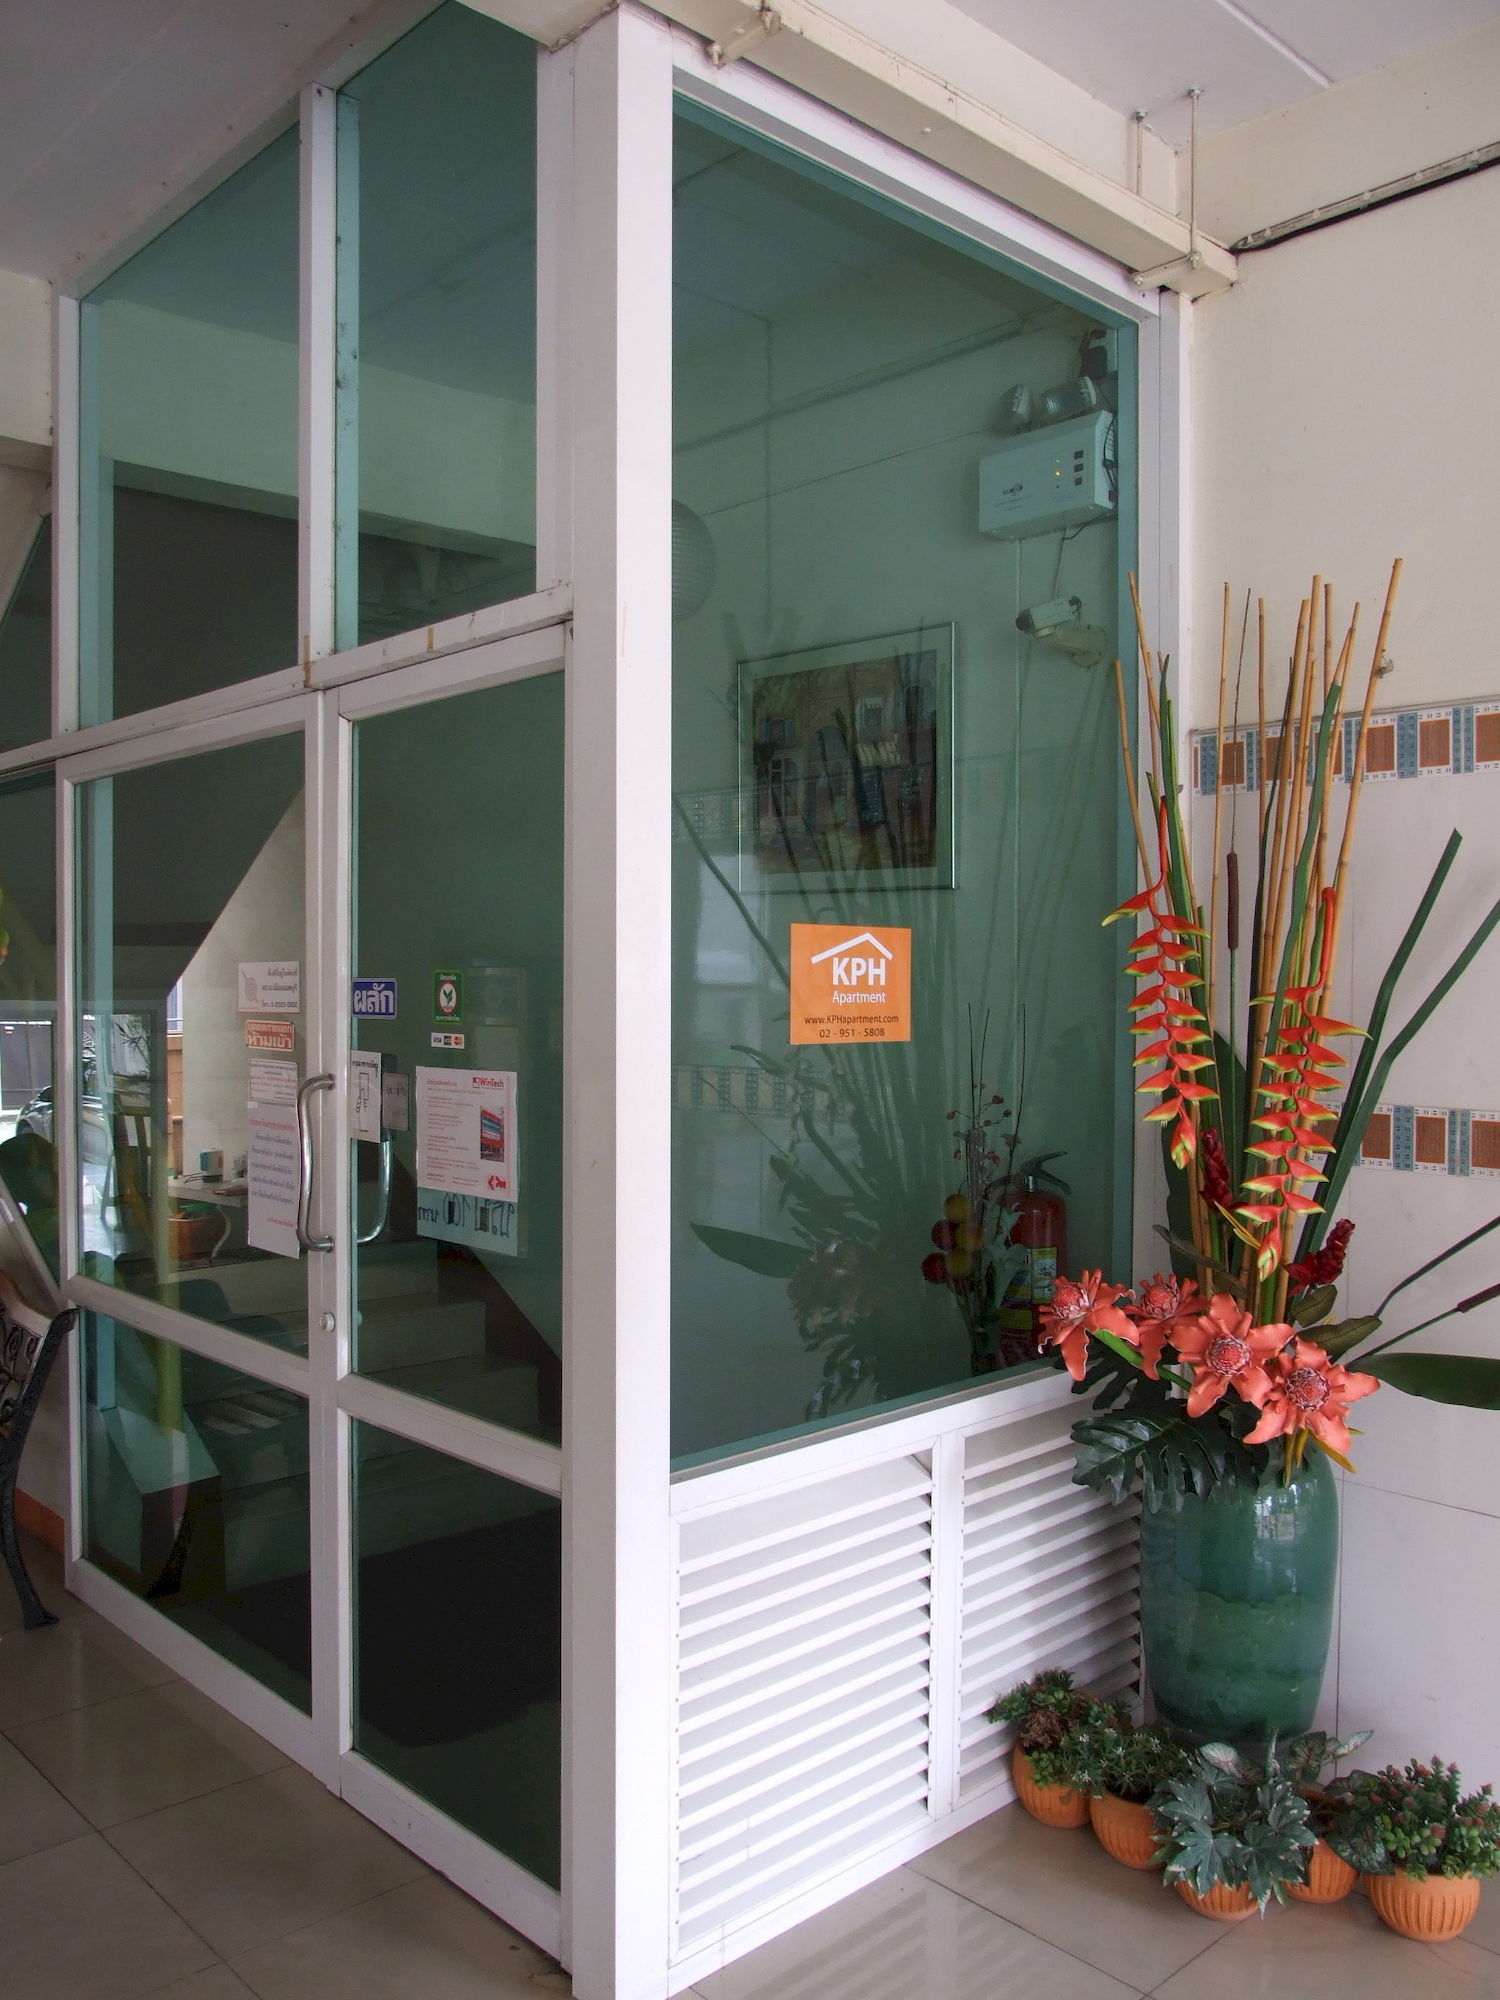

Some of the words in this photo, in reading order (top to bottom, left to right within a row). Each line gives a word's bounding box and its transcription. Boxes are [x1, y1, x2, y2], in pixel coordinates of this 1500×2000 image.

[832, 957, 886, 986] KPH
[353, 982, 394, 1014] ผลัก
[832, 990, 886, 1006] Apartment
[804, 1014, 899, 1025] www.KPHapartment.com
[247, 1030, 292, 1049] ห้ามเข้า
[819, 1029, 831, 1038] 02
[839, 1028, 855, 1037] 951
[864, 1028, 885, 1037] 5808
[479, 1076, 505, 1088] WinTech
